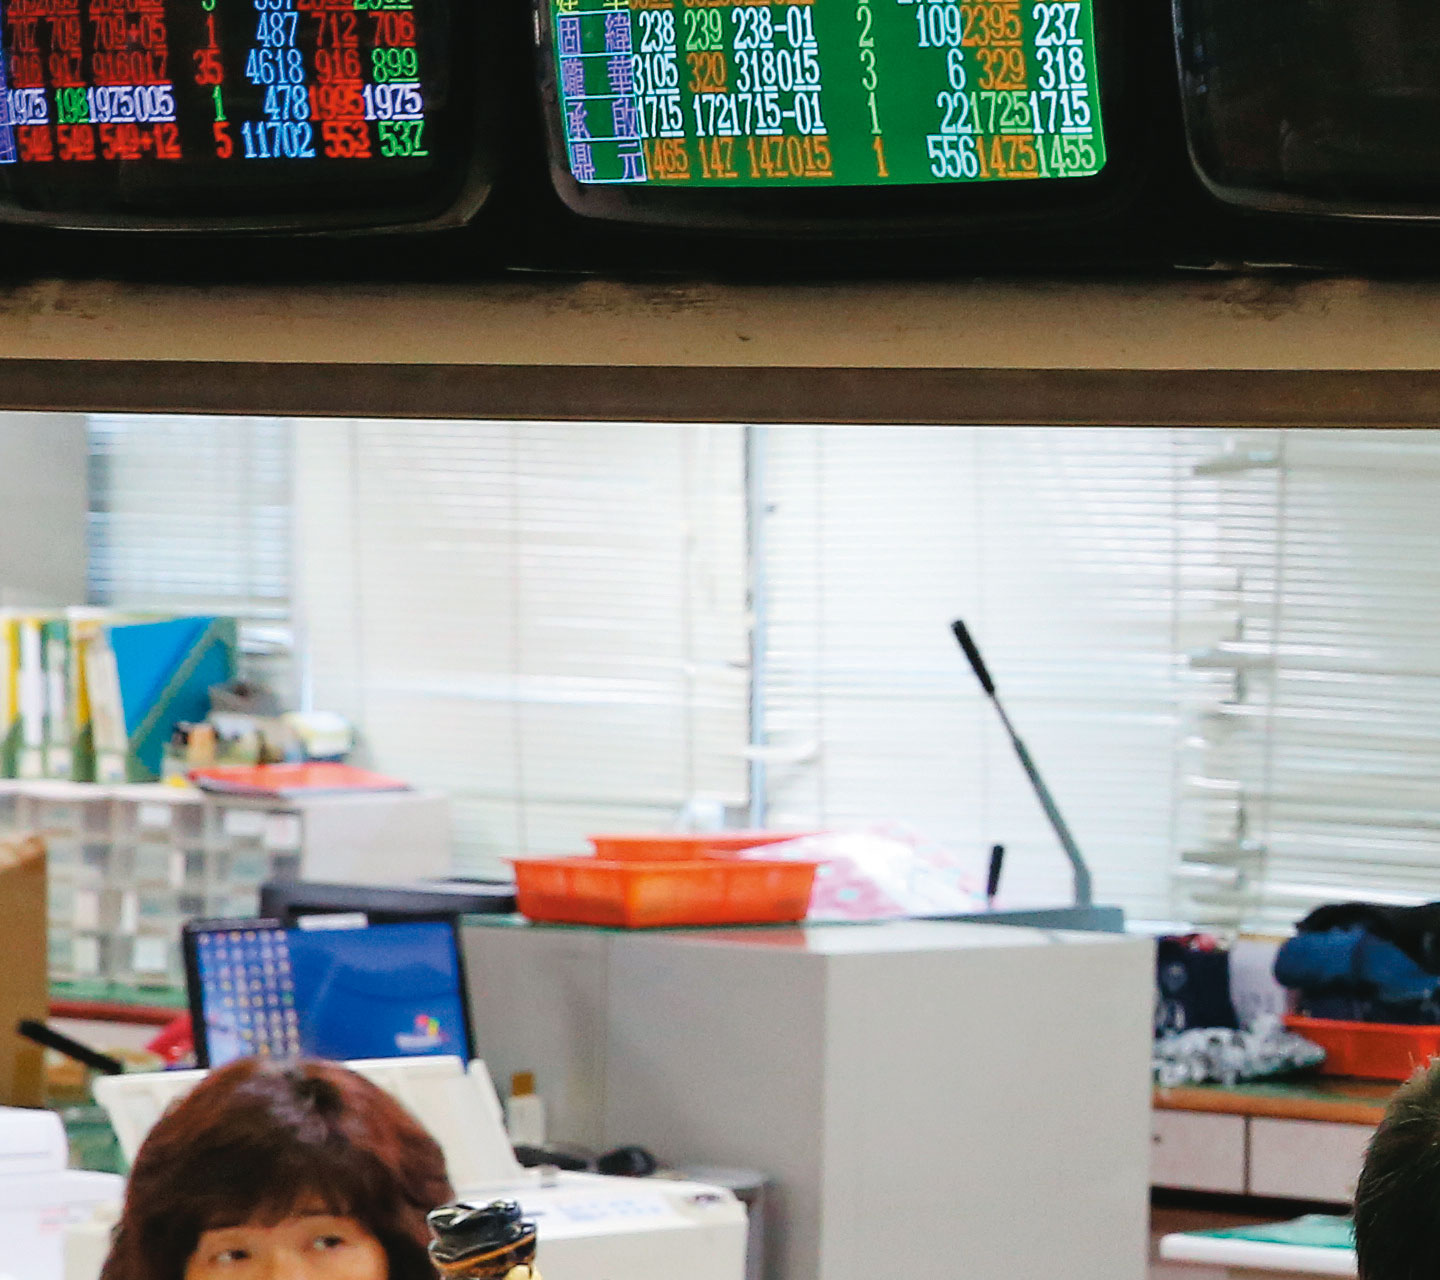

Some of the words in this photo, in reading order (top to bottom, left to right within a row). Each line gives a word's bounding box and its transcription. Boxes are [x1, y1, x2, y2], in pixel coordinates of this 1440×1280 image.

[639, 12, 674, 52] 238
[1035, 4, 1082, 45] 237
[372, 49, 418, 83] 899
[1037, 47, 1087, 89] 318
[937, 93, 972, 133] 22
[1031, 90, 1091, 133] 1715
[380, 121, 428, 156] 537
[928, 136, 976, 177] 556
